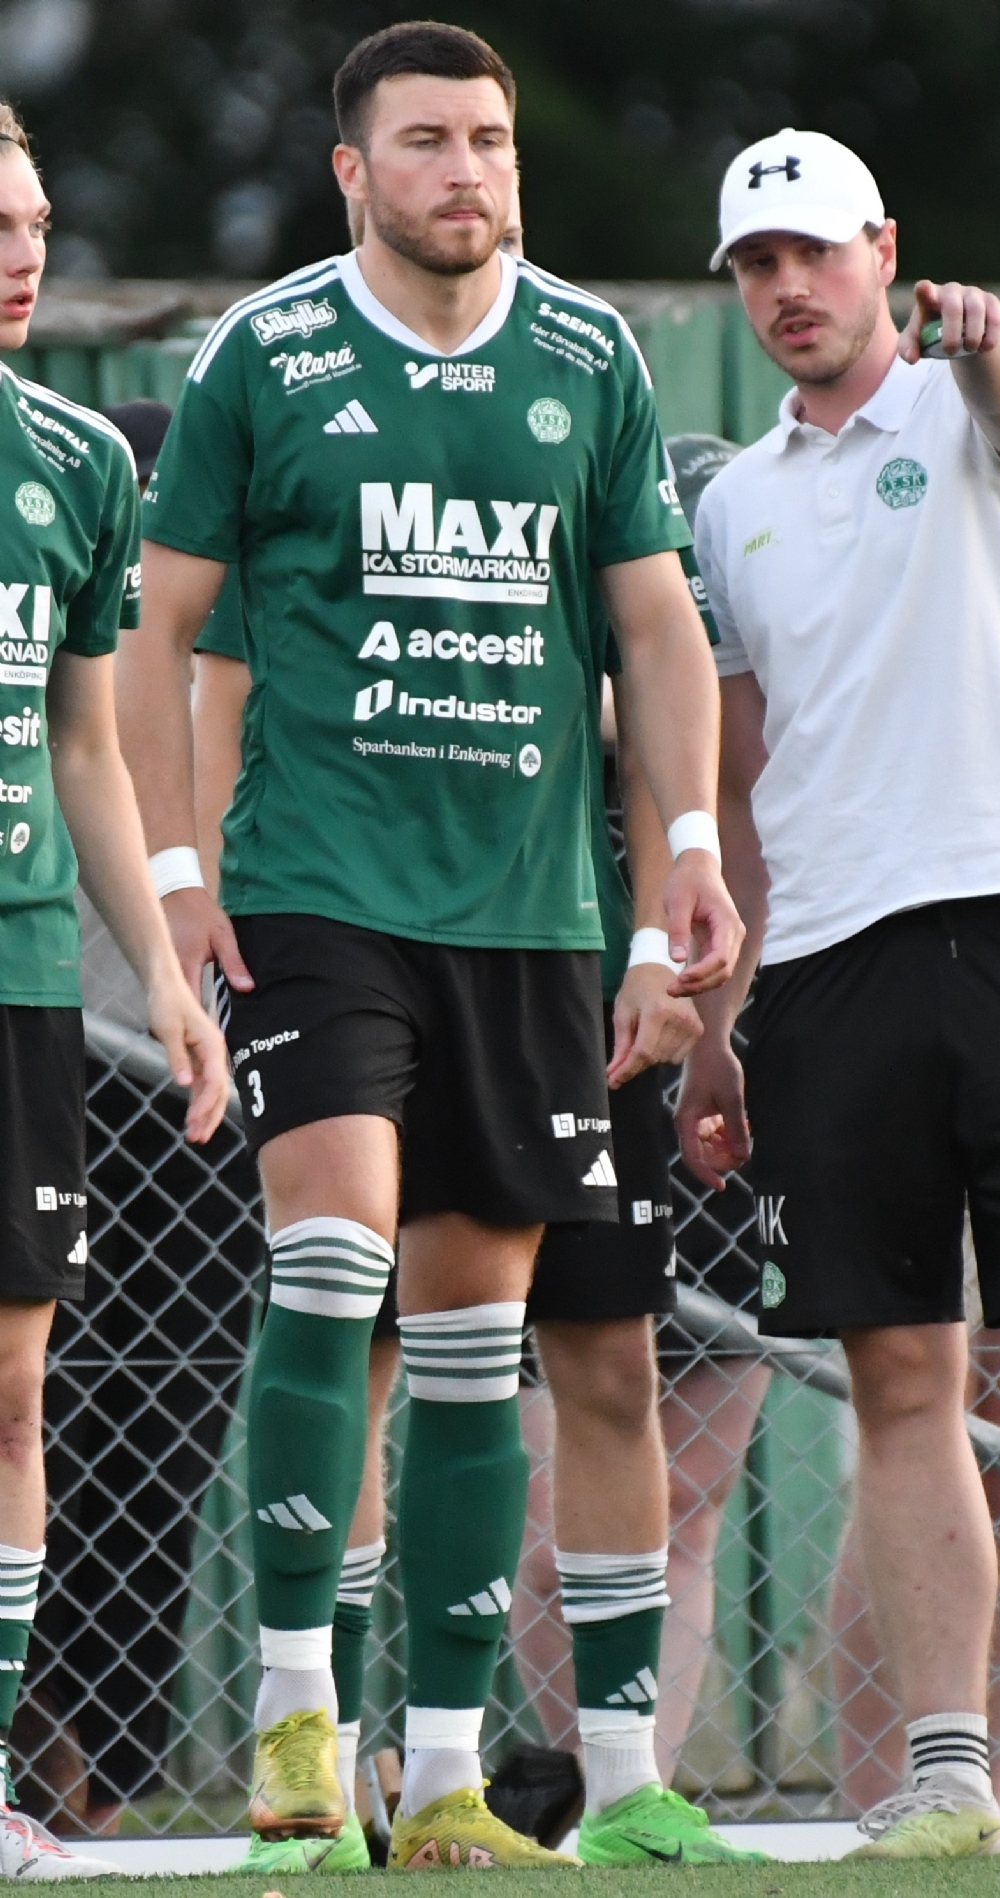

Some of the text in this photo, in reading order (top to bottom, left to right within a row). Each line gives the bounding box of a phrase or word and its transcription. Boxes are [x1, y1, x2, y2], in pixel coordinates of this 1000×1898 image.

[253, 300, 335, 343] Sibylla
[538, 302, 615, 356] S-RENTAL
[441, 362, 495, 379] INTER
[593, 358, 609, 371] AB
[442, 376, 496, 392] SPORT
[17, 396, 90, 454] S-RENTAL
[360, 482, 559, 560] MAXI
[362, 552, 550, 581] ICA STORMARKNAD
[407, 625, 544, 666] accesit
[398, 691, 542, 724] Industor
[352, 737, 511, 768] Sparbanken i Enköping
[250, 1030, 300, 1054] Toyota
[248, 1069, 265, 1117] 3
